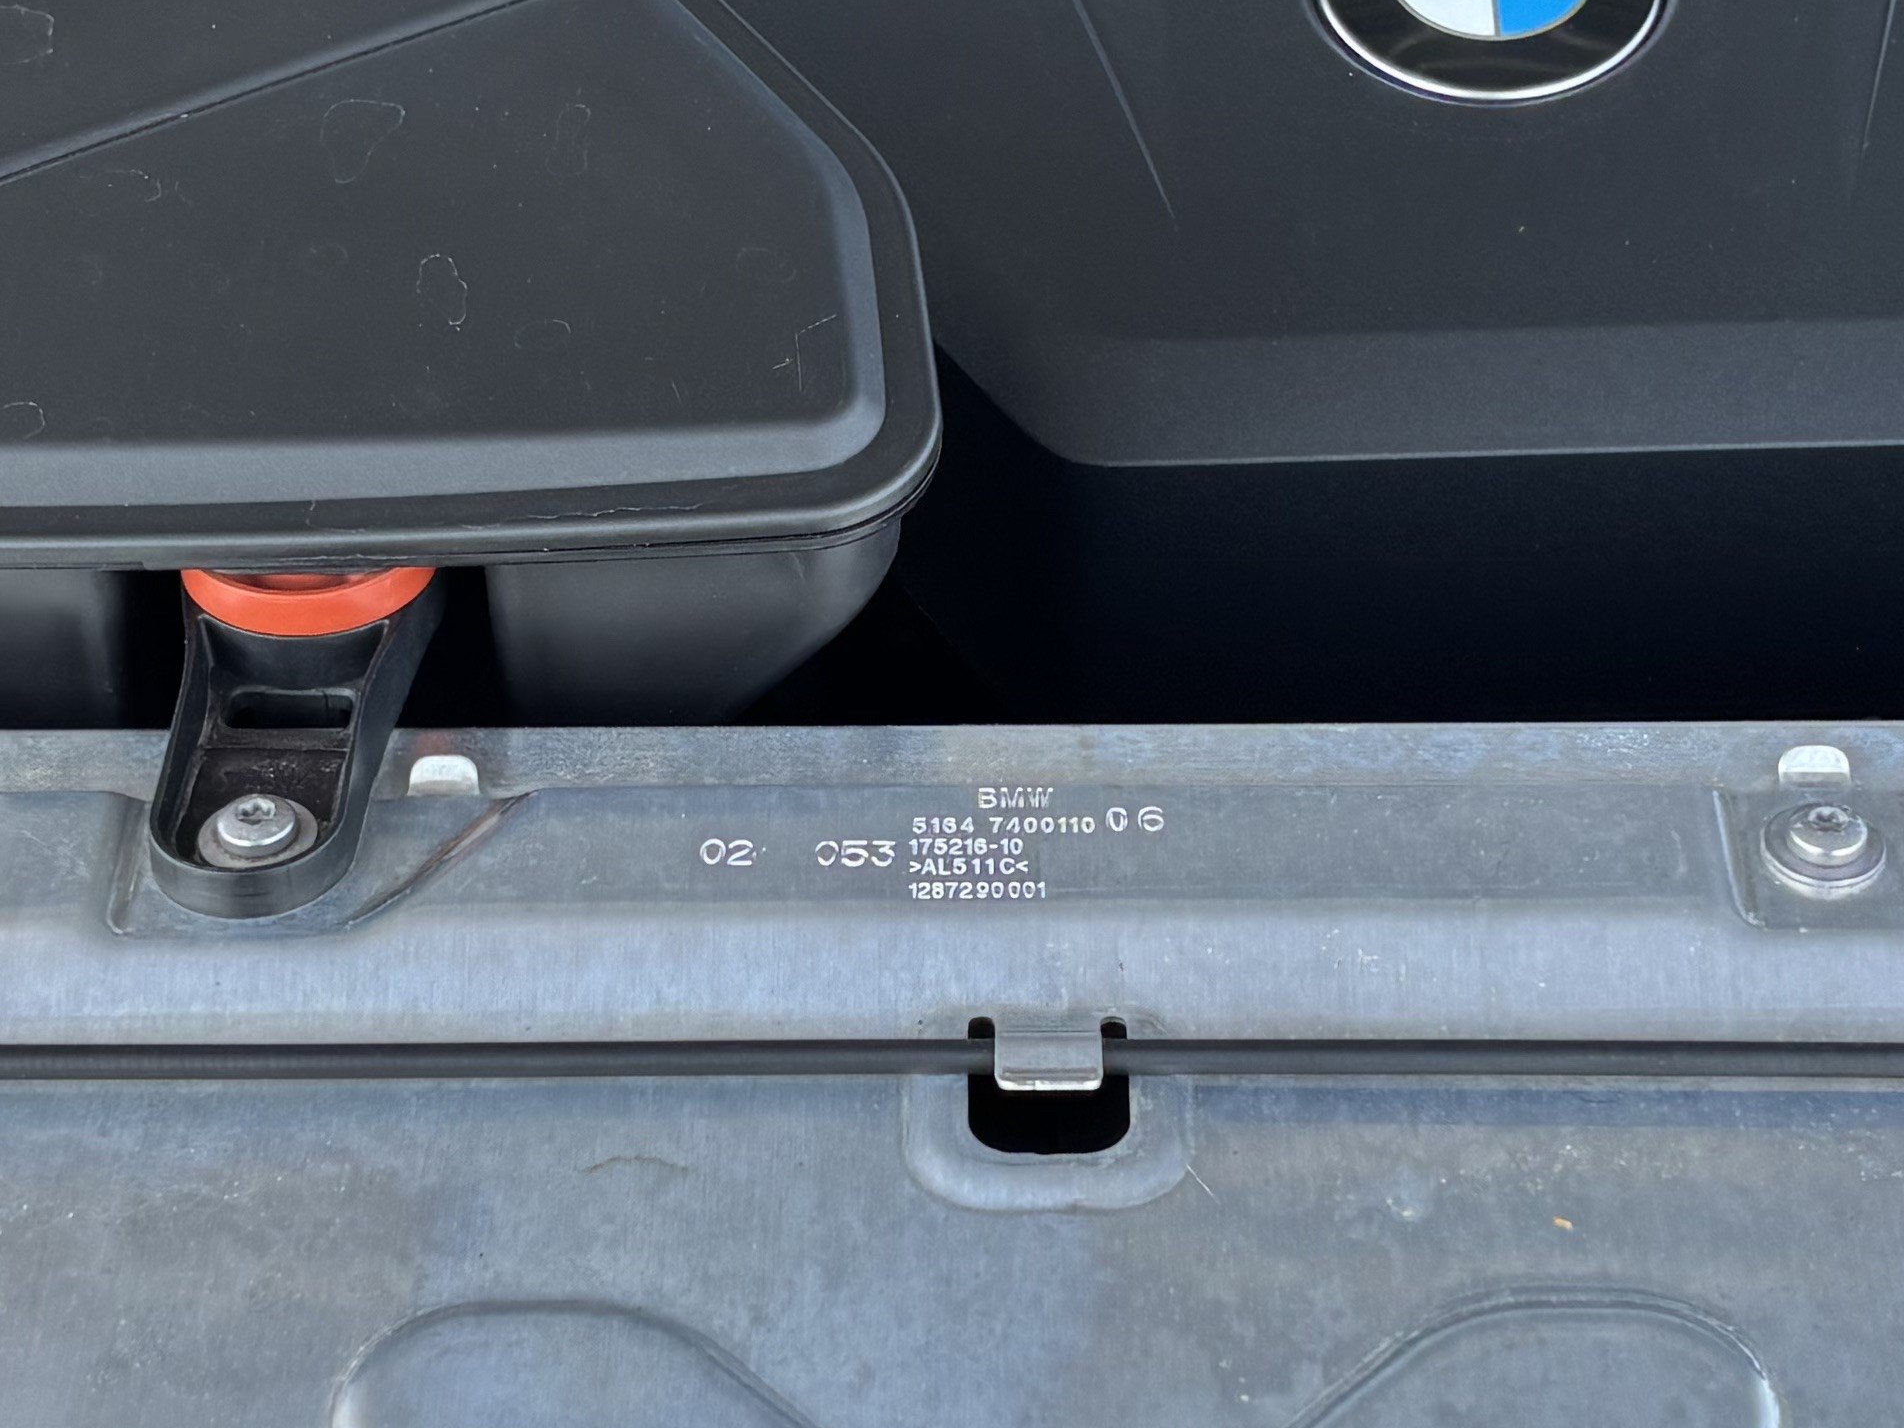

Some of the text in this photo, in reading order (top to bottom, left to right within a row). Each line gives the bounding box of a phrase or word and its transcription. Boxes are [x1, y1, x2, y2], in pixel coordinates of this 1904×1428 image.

[978, 787, 1054, 809] BMW
[989, 817, 1096, 834] 7400110
[815, 840, 896, 867] 053
